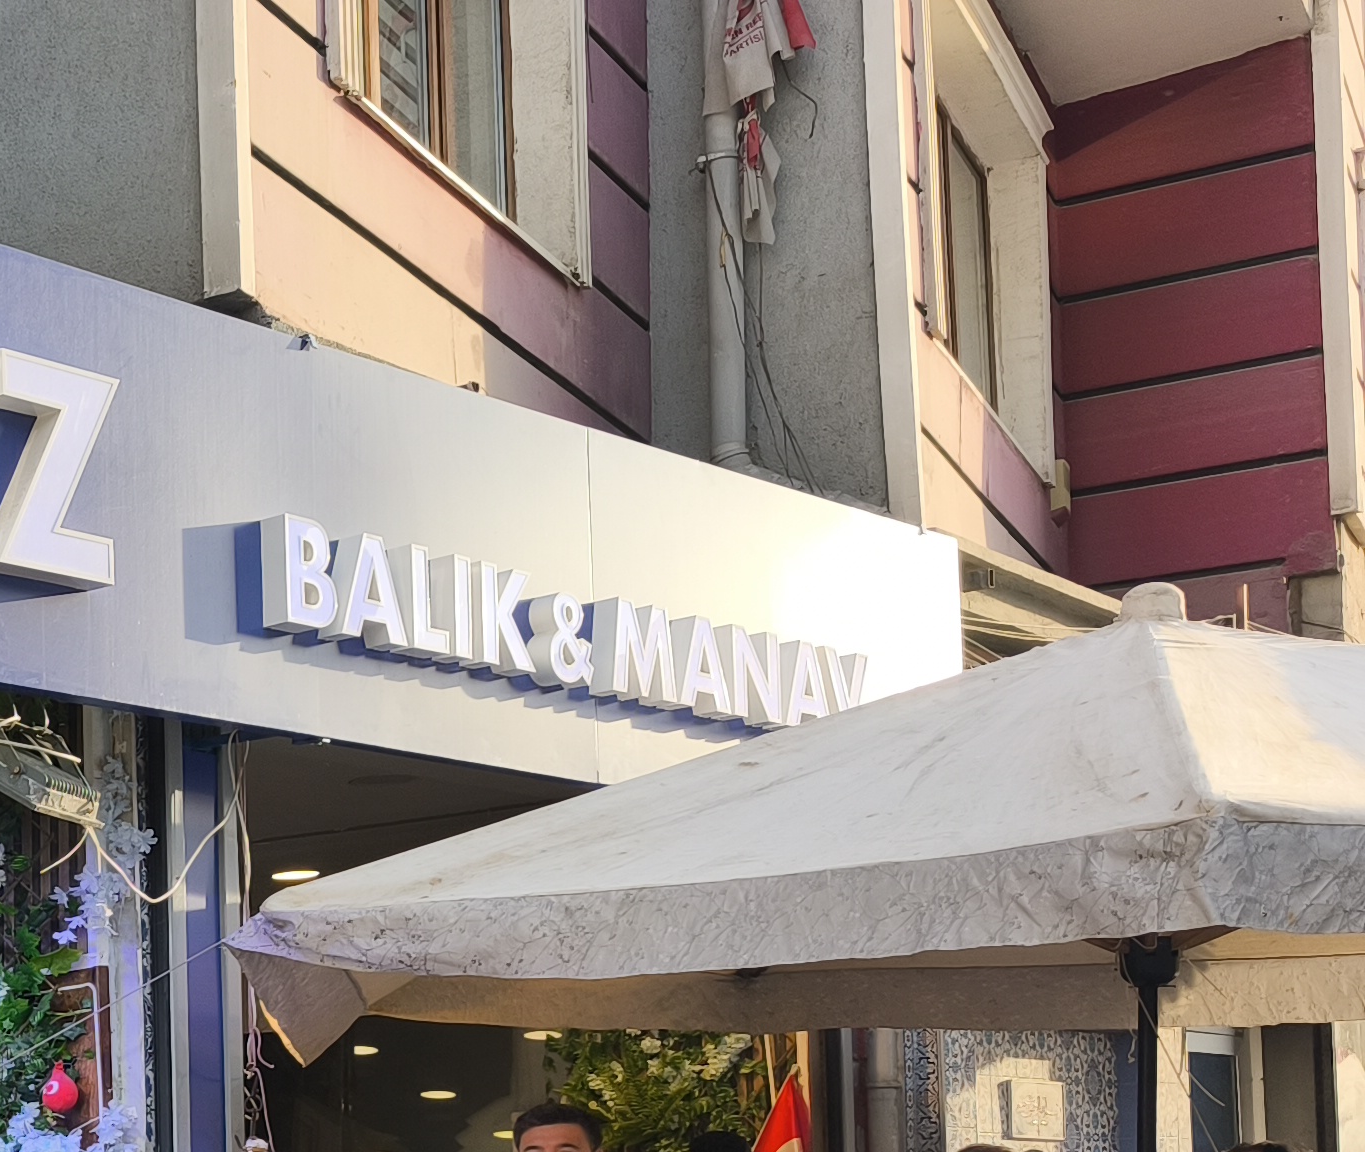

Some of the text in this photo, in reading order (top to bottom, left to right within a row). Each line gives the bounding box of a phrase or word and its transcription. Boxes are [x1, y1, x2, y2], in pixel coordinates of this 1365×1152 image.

[262, 513, 869, 727] BALIK & MANAV
